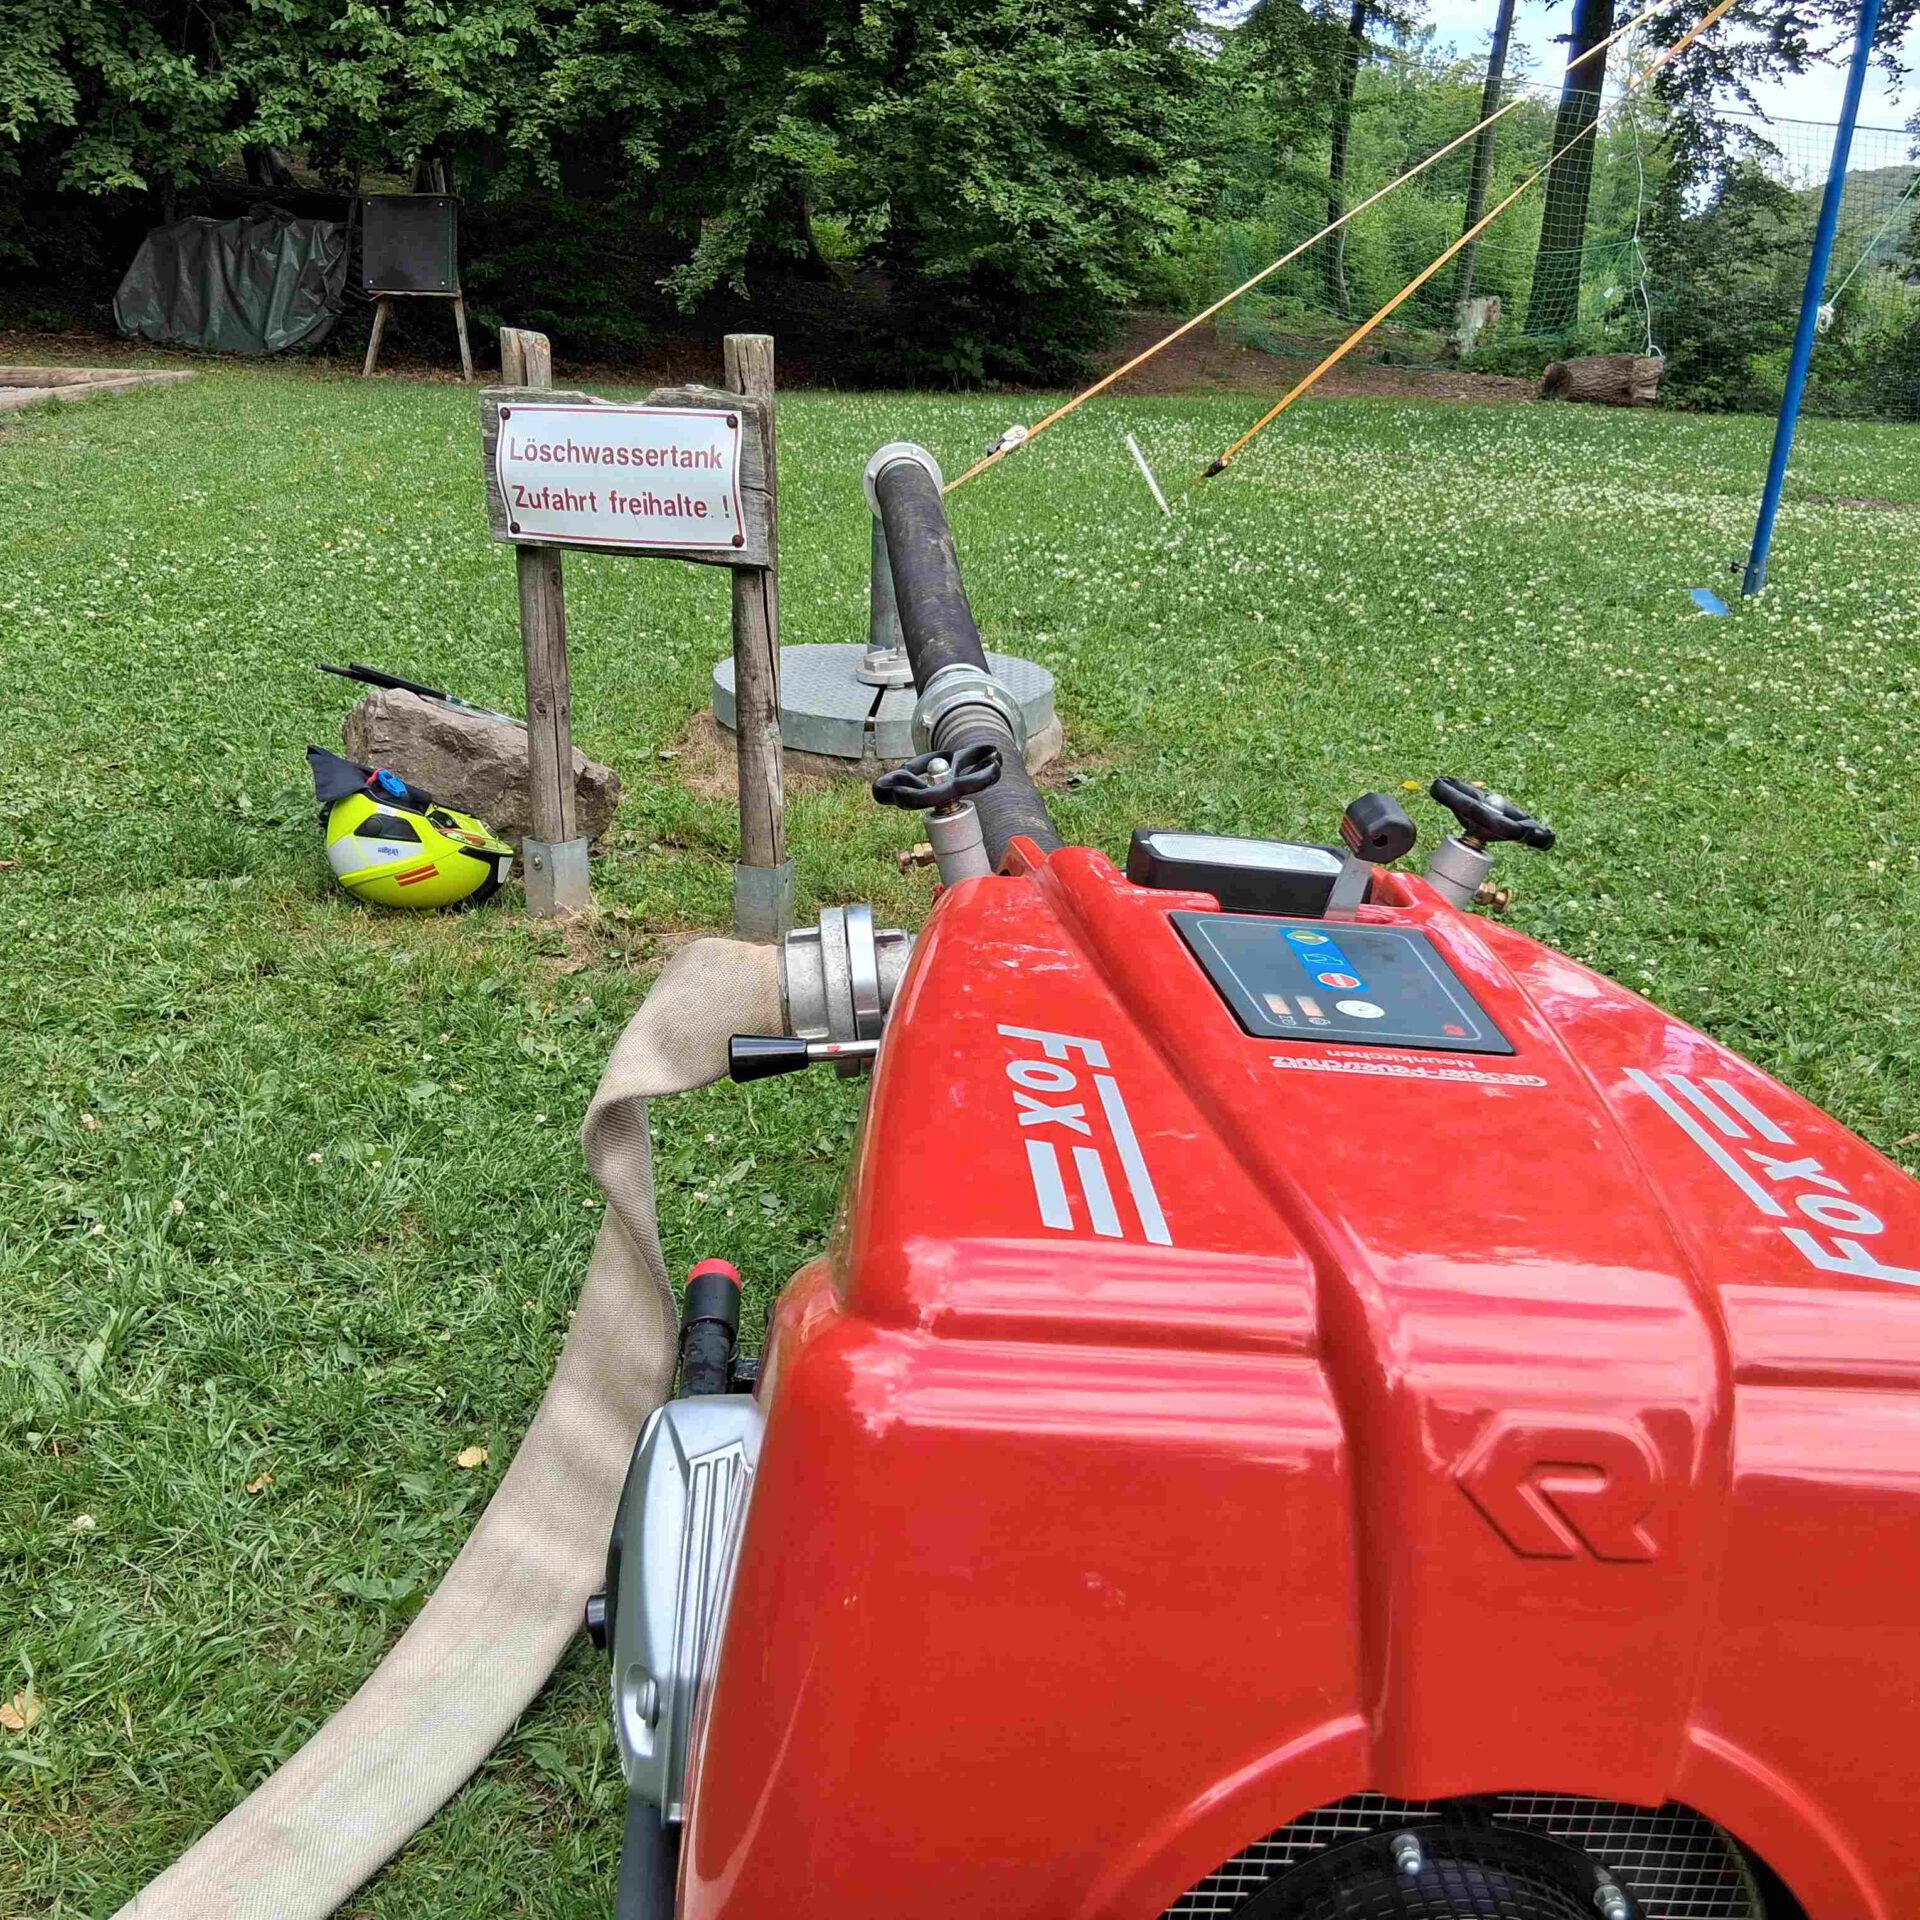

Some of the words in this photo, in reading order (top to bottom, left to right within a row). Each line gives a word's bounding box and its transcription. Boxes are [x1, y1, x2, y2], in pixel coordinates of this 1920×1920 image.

[510, 437, 723, 469] Löschwassertank
[512, 485, 598, 513] Zufahrt
[1325, 1049, 1476, 1069] Neunkirchen
